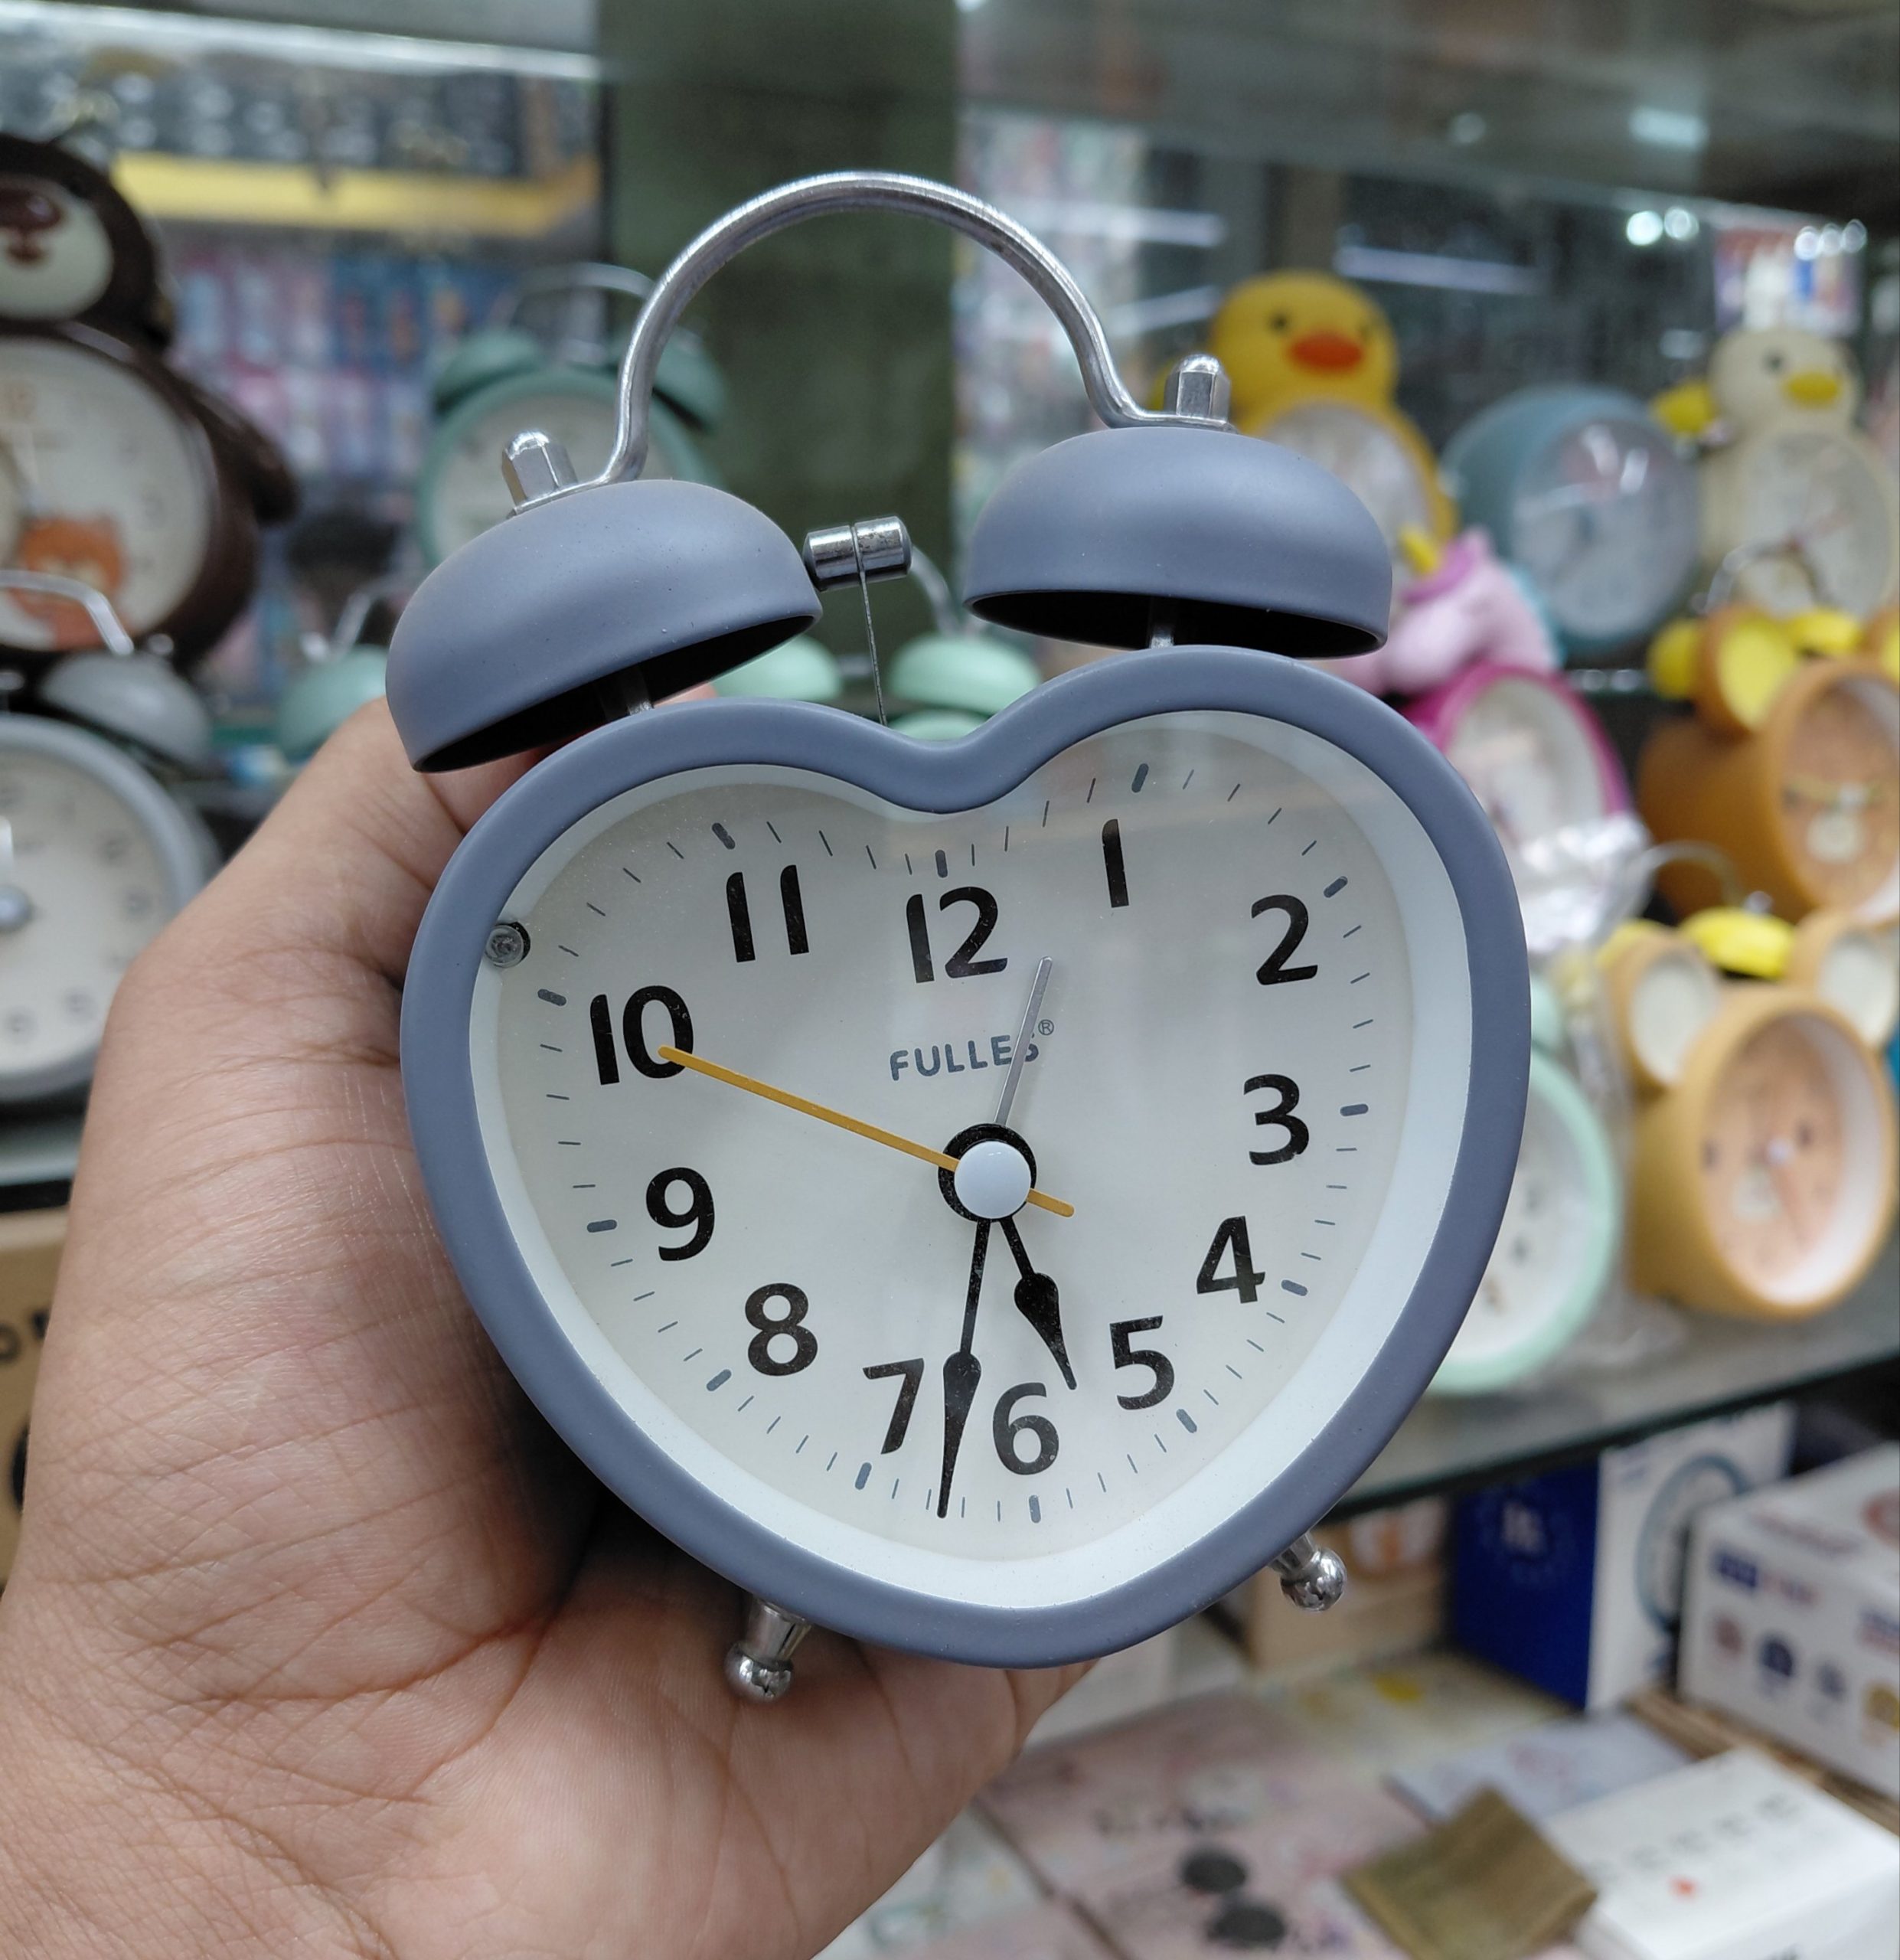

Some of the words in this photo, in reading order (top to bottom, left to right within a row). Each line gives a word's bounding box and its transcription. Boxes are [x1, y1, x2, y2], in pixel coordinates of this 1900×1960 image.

[1102, 818, 1129, 908] 1
[726, 864, 809, 962] 11
[906, 886, 1008, 984] 12
[1251, 894, 1318, 985] 2
[589, 985, 694, 1086] 10
[1243, 1073, 1310, 1165] 3
[645, 1167, 715, 1261] 9
[1196, 1216, 1265, 1304] 4
[744, 1282, 818, 1377] 8
[1109, 1315, 1175, 1410] 5
[862, 1357, 925, 1455] 7
[992, 1382, 1059, 1475] 6
